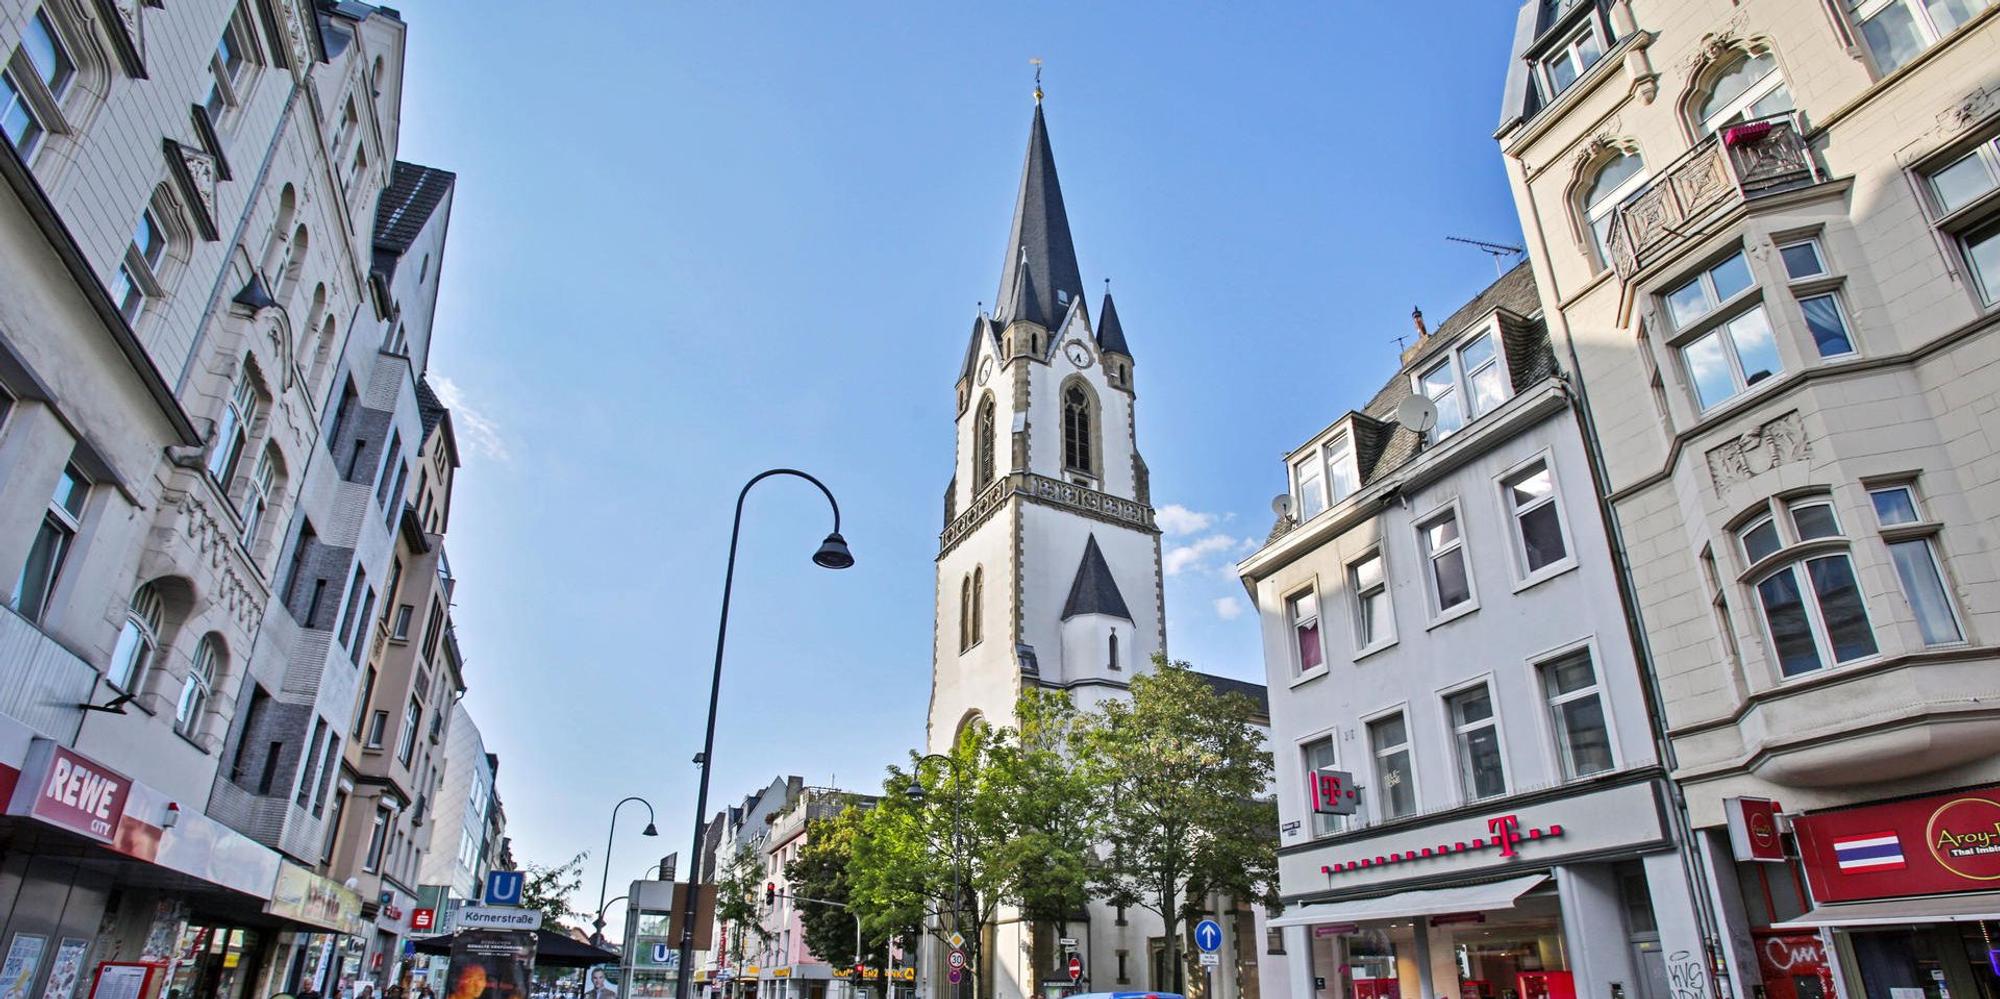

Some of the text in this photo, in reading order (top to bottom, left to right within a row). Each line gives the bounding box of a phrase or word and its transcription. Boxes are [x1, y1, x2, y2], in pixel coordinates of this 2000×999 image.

[46, 757, 118, 819] REWE
[91, 819, 111, 835] CITY
[1951, 848, 1974, 857] Thai
[493, 875, 516, 900] U
[465, 911, 534, 924] Körnerstraße
[653, 944, 670, 962] U
[952, 955, 961, 964] 30
